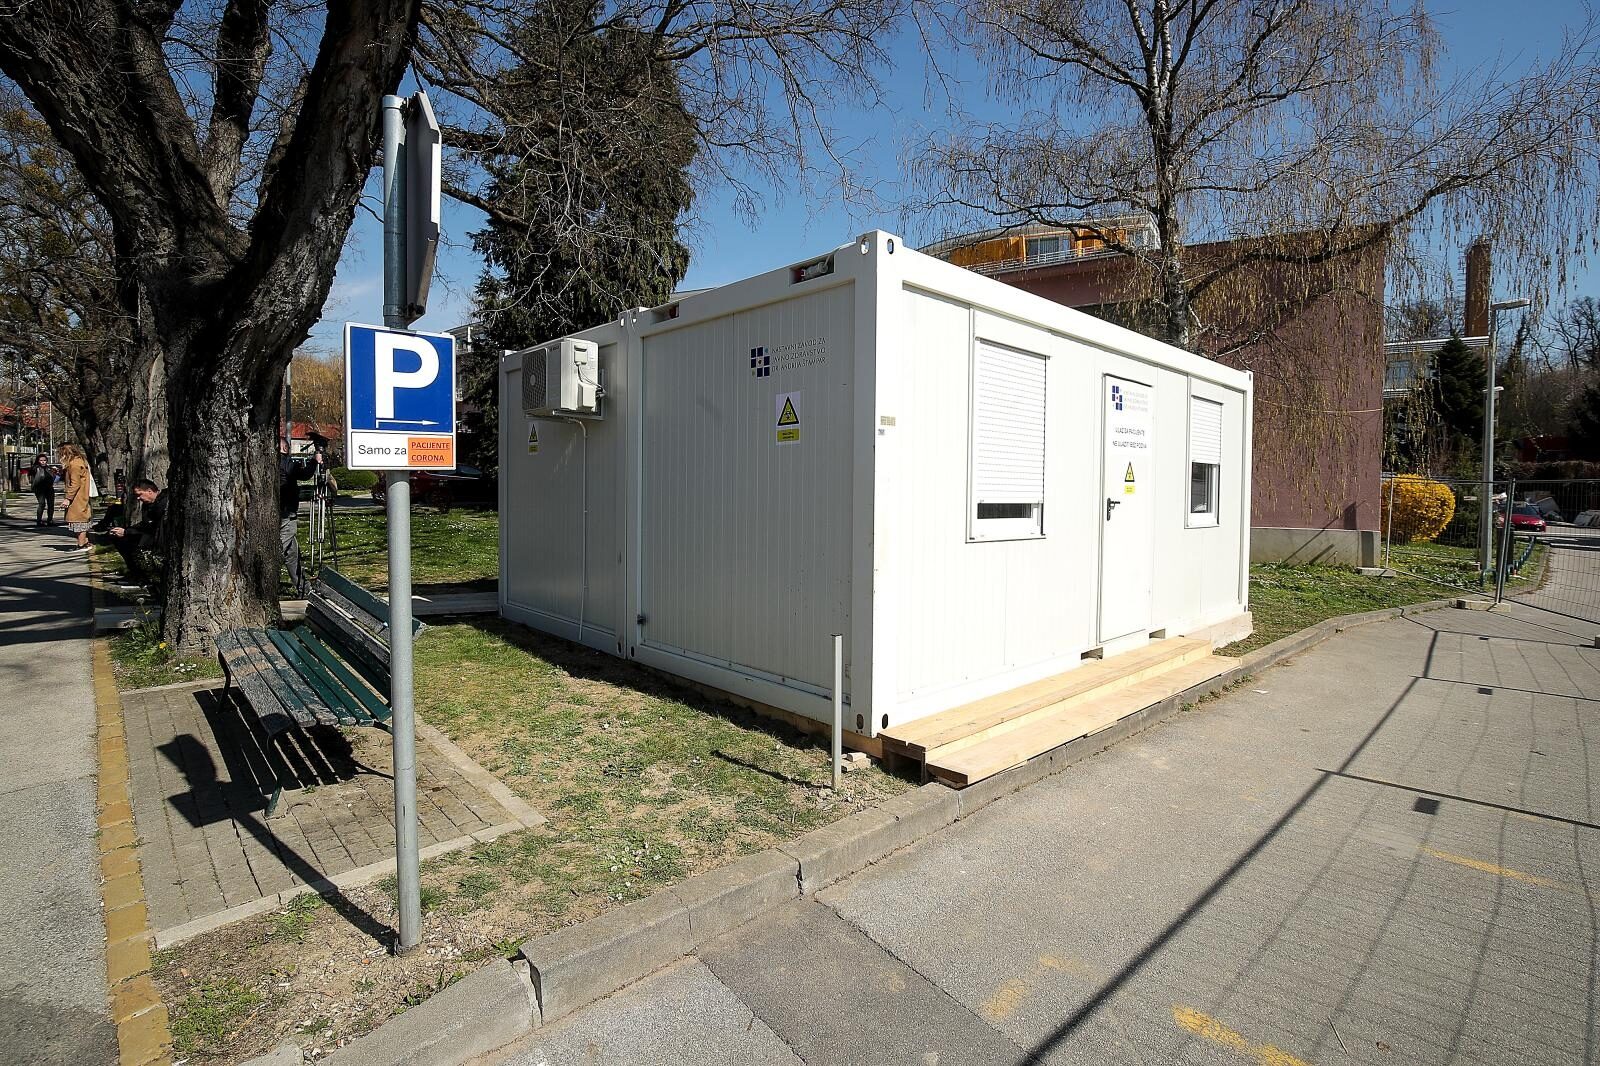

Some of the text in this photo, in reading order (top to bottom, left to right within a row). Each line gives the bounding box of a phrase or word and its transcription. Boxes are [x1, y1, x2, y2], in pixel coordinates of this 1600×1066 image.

[375, 332, 440, 418] P
[358, 444, 407, 455] Samo za
[411, 441, 450, 449] PACIJENTE
[411, 454, 445, 462] CORONA
